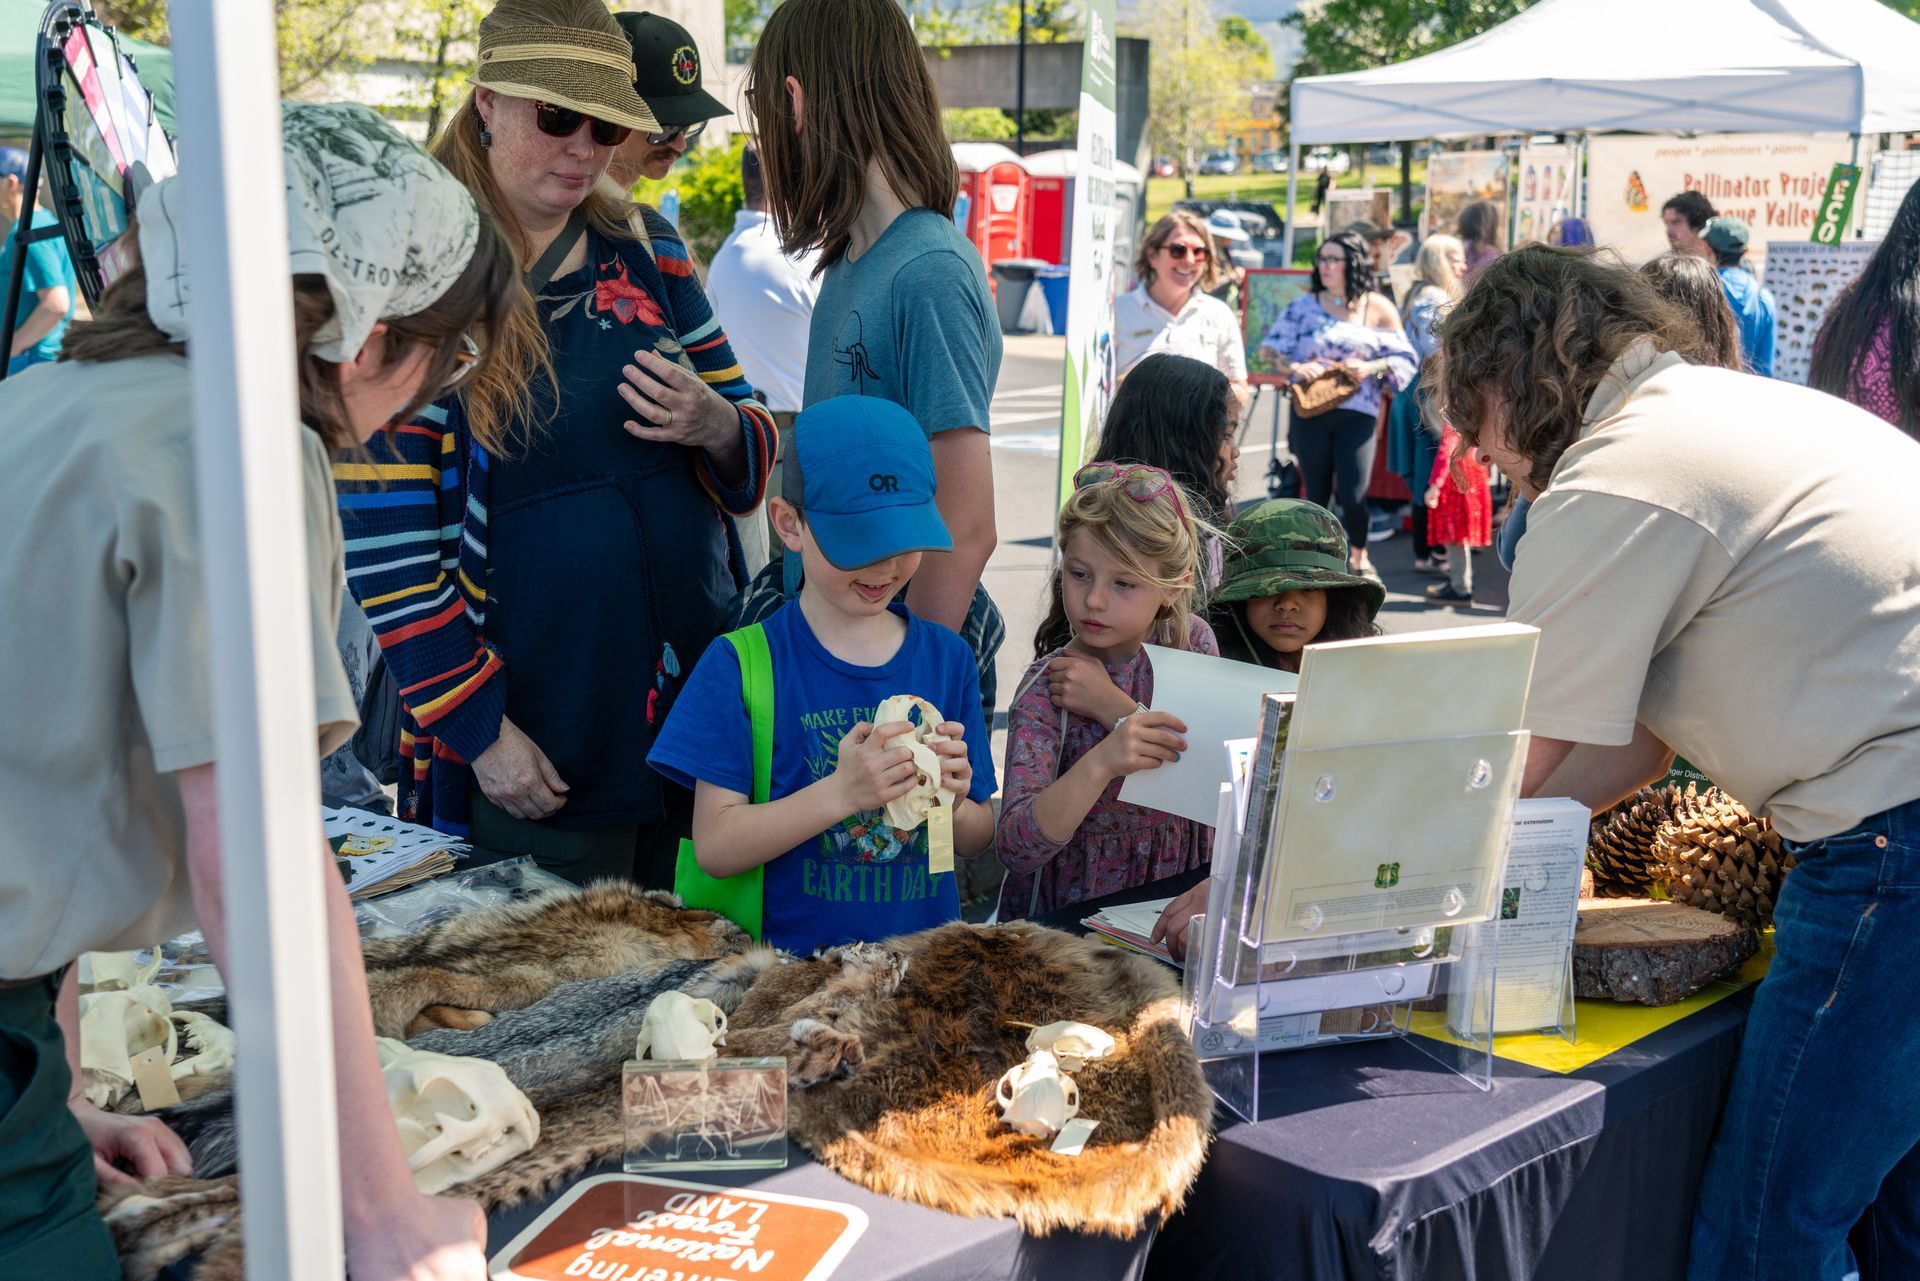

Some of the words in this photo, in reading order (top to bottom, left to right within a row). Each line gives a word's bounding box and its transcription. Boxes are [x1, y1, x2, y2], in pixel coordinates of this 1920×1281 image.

[1702, 144, 1760, 157] pollinators
[1684, 173, 1769, 197] Pollinator
[1780, 172, 1826, 200] Proje
[869, 473, 899, 492] OR
[800, 708, 847, 731] MAKE
[803, 859, 891, 902] EARTH
[901, 864, 944, 900] DAY
[664, 1193, 769, 1224] LAND
[626, 1210, 760, 1246] Forest
[584, 1227, 775, 1273] National
